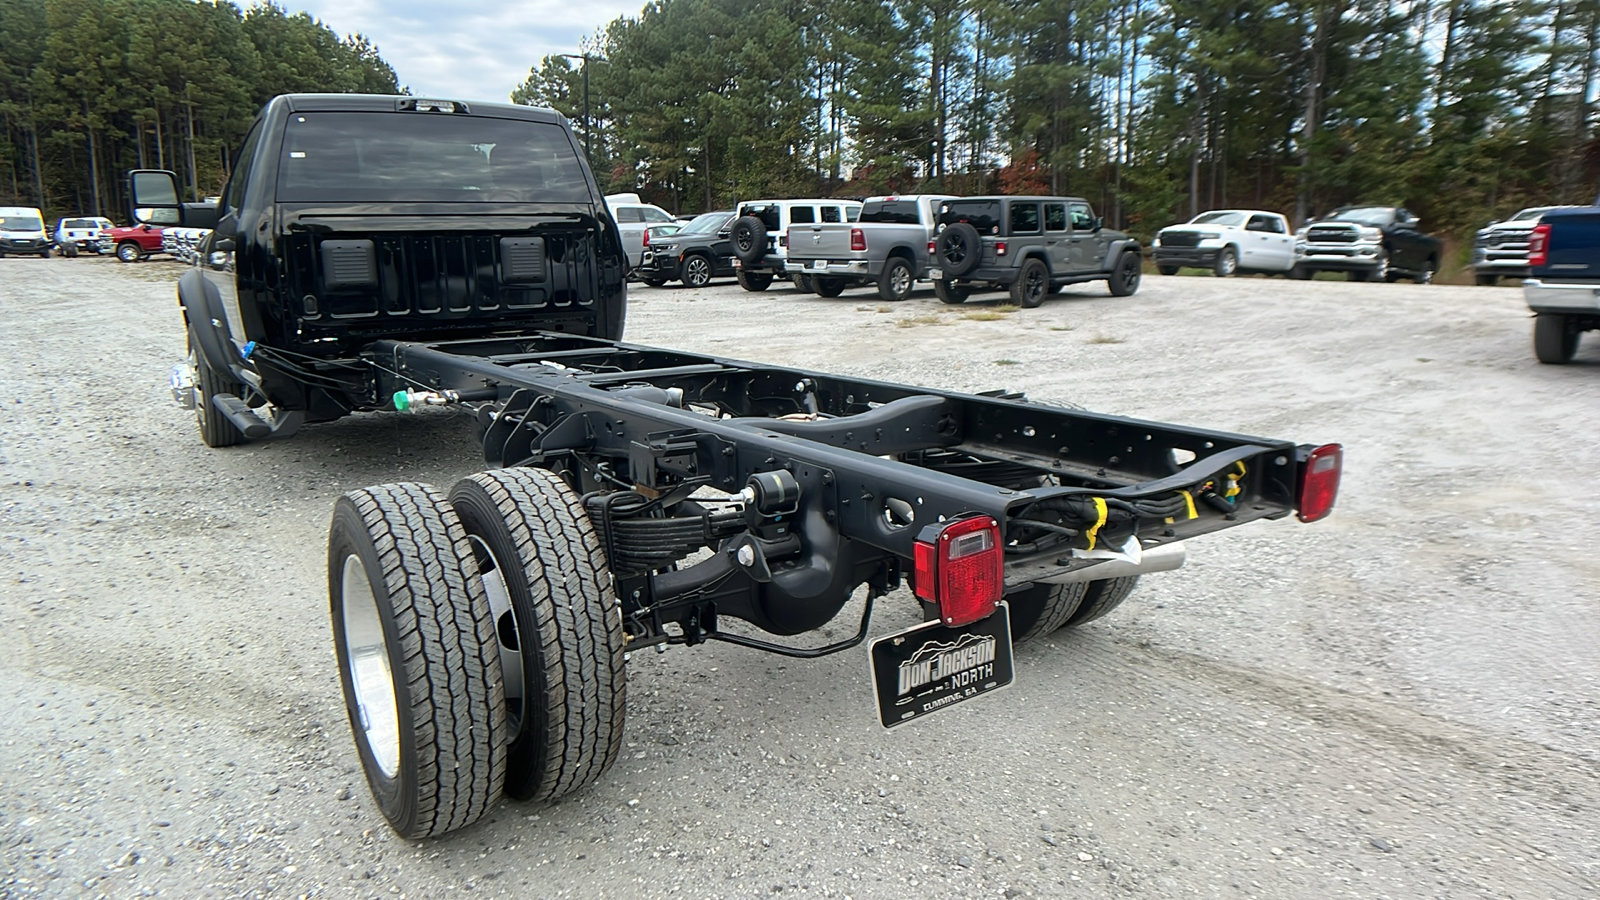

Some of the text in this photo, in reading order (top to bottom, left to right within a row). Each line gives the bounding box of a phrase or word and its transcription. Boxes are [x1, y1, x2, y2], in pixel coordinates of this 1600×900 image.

[899, 639, 996, 696] DON JACKSON
[951, 663, 993, 689] NORTH
[965, 687, 978, 697] GA
